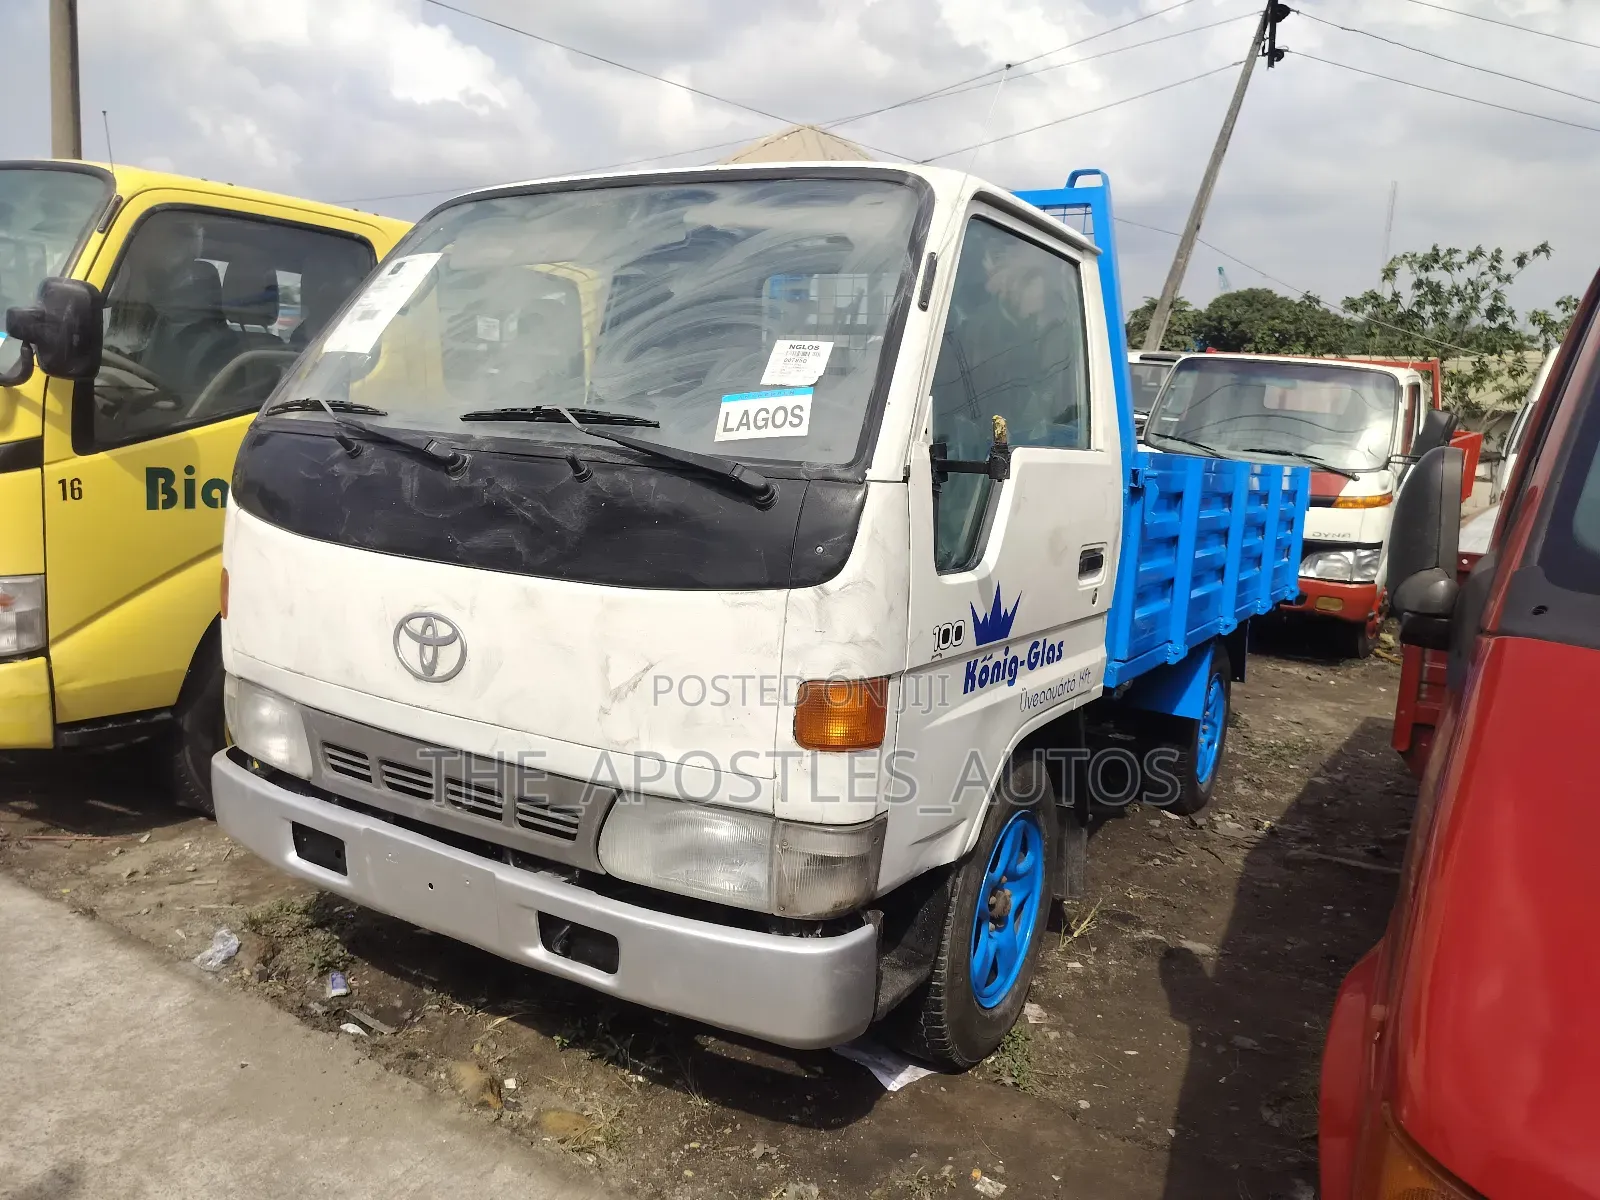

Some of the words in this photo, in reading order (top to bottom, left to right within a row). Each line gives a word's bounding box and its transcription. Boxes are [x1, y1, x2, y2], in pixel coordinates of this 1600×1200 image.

[722, 404, 804, 433] LAGOS
[58, 477, 83, 501] 16
[932, 619, 965, 652] 100
